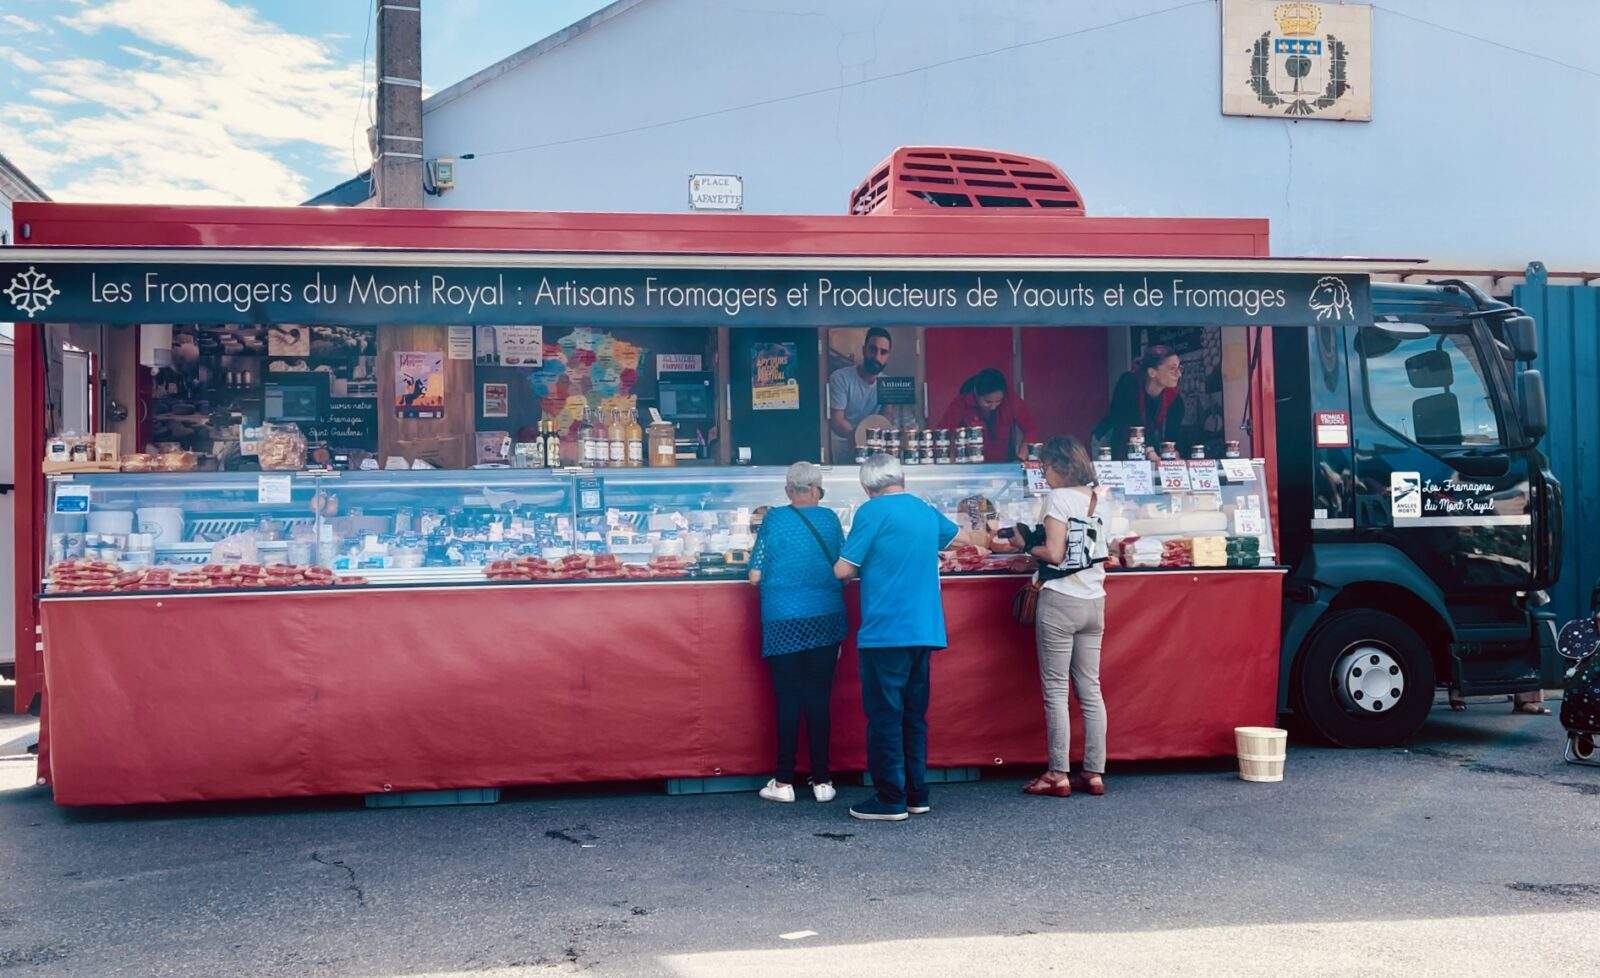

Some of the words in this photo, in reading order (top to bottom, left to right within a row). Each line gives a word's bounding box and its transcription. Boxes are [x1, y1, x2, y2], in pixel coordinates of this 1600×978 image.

[702, 178, 729, 186] PLACE
[690, 194, 741, 204] LAFAYETTE
[92, 272, 132, 303] Les
[146, 273, 292, 313] Fromagers
[303, 272, 337, 304] du
[348, 274, 421, 305] Mont
[432, 273, 504, 314] Royal
[535, 276, 634, 307] Artisans
[646, 277, 777, 315] Fromagers
[786, 282, 808, 307] et
[818, 277, 957, 307] Producteurs
[967, 277, 998, 307] de
[1006, 279, 1095, 308] Yaourts
[1104, 283, 1125, 307] et
[1132, 277, 1164, 307] de
[1173, 279, 1286, 315] Fromages
[1422, 479, 1441, 494] Les
[1443, 479, 1495, 496] Fromagers
[1424, 499, 1438, 511] du
[1439, 498, 1464, 513] Mont
[1465, 498, 1495, 515] Royal
